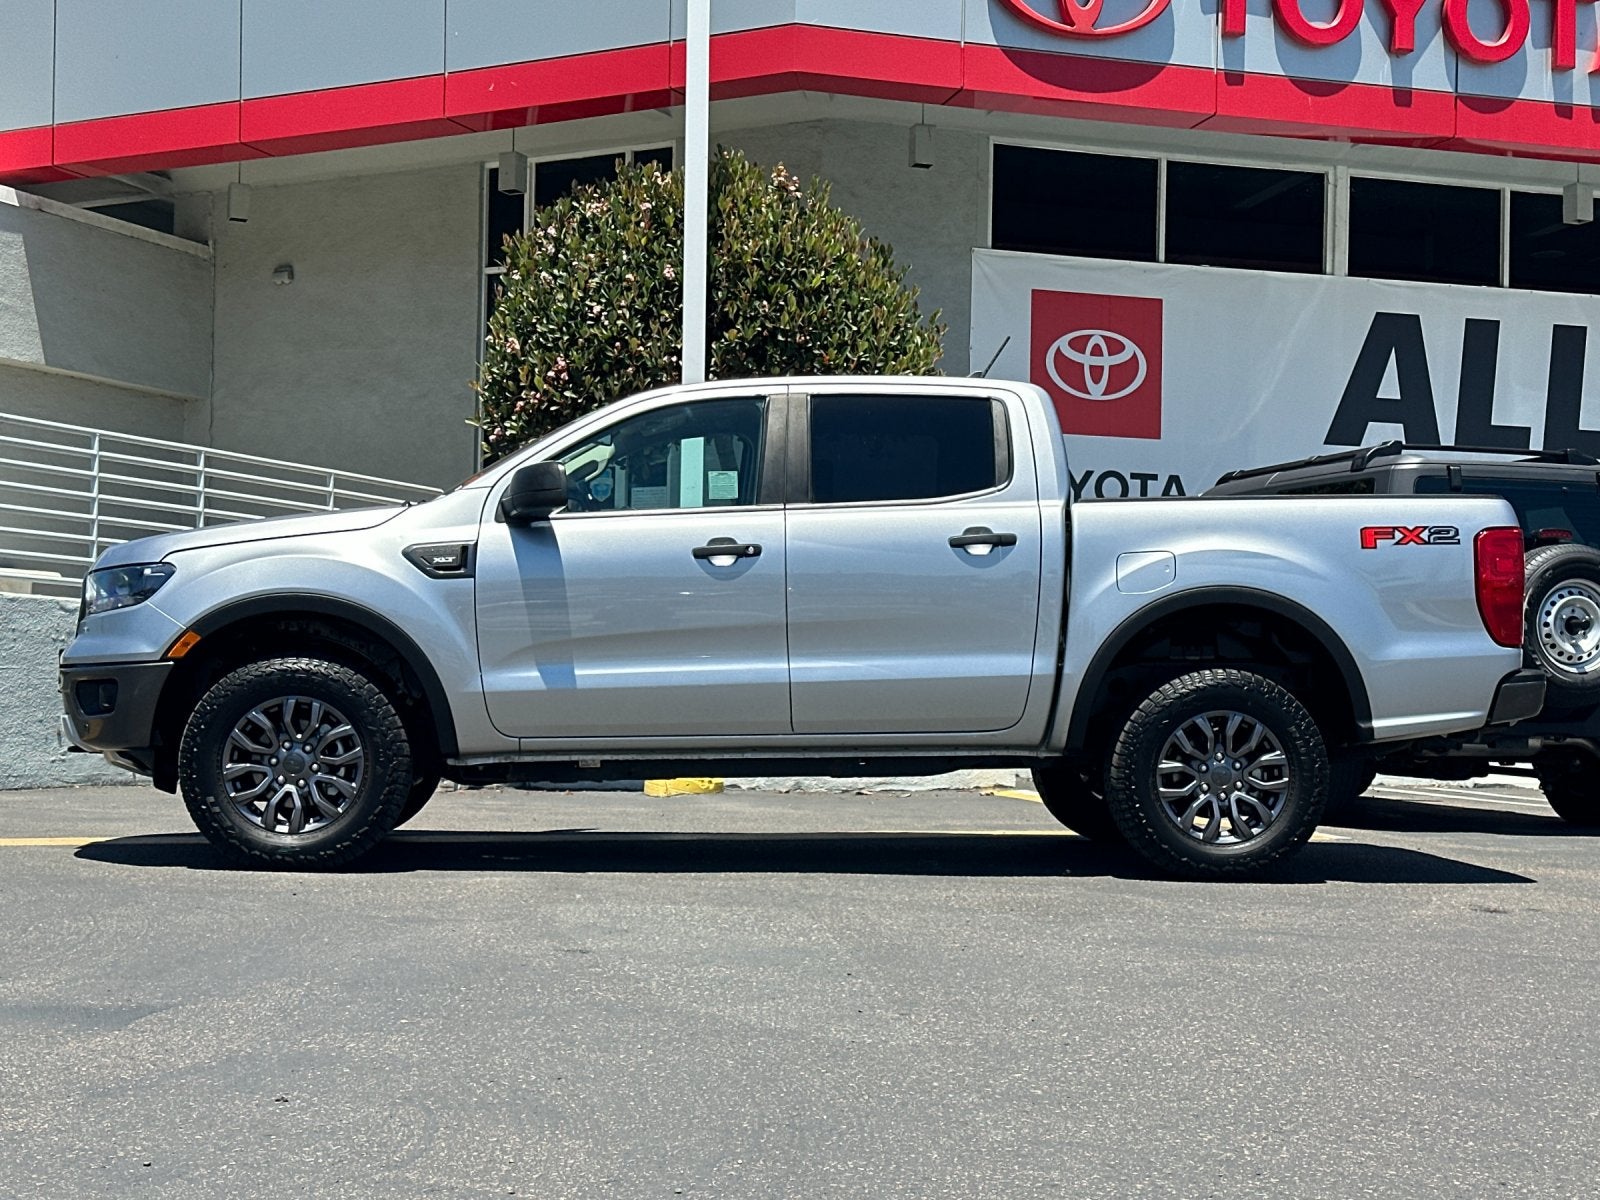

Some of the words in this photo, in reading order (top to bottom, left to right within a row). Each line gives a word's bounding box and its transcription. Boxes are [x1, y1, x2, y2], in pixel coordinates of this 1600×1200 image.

[1221, 0, 1600, 76] OYOT
[1323, 311, 1600, 456] ALL
[432, 556, 457, 564] XLT
[1360, 526, 1461, 550] FX2
